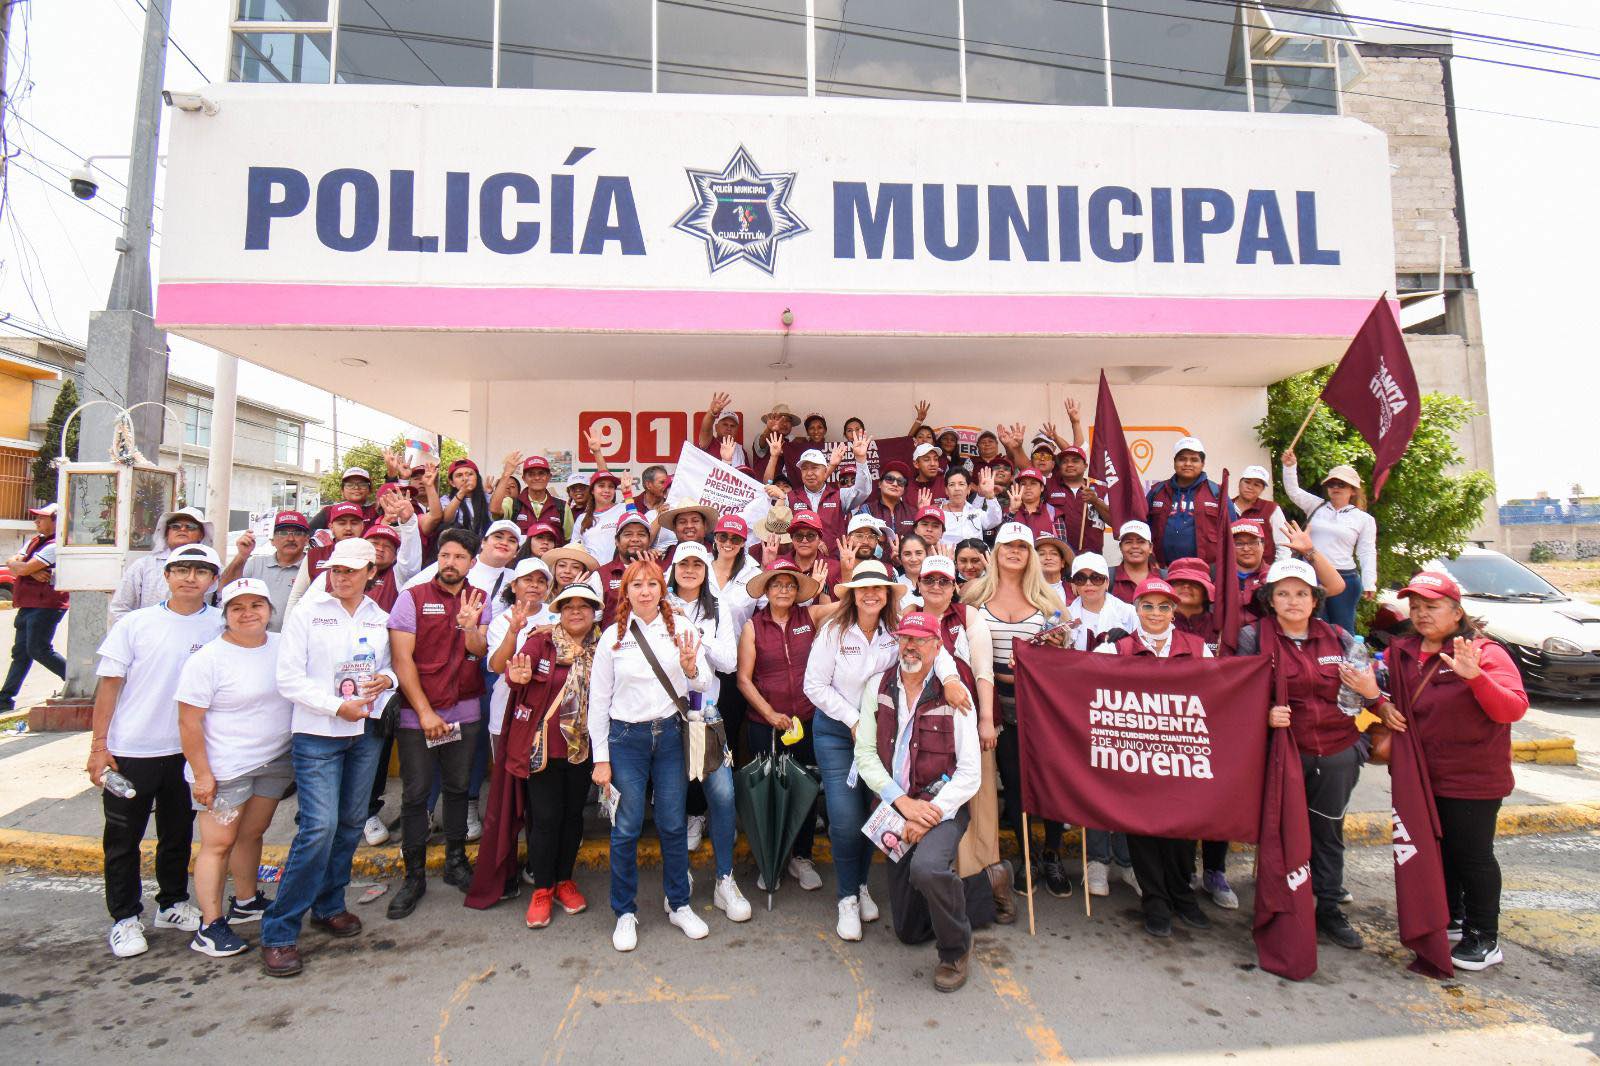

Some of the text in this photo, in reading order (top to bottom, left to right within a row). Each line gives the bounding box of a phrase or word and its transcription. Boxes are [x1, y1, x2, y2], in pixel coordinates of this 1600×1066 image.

[713, 184, 767, 195] POLICÍA MUNICIPAL
[244, 146, 1341, 266] POLICÍA MUNICIPAL
[717, 230, 766, 240] CUAUTITLÁN
[704, 478, 755, 499] PRESIDENTA
[1231, 524, 1260, 535] morena
[1089, 688, 1207, 718] JUANITA
[1089, 709, 1209, 734] PRESIDENTA
[1090, 727, 1210, 745] JUNTOS CUIDEMOS CUAUTITLÁN
[1091, 736, 1212, 756] 2 DE JUNIO VOTA TODO
[1090, 745, 1214, 779] morena
